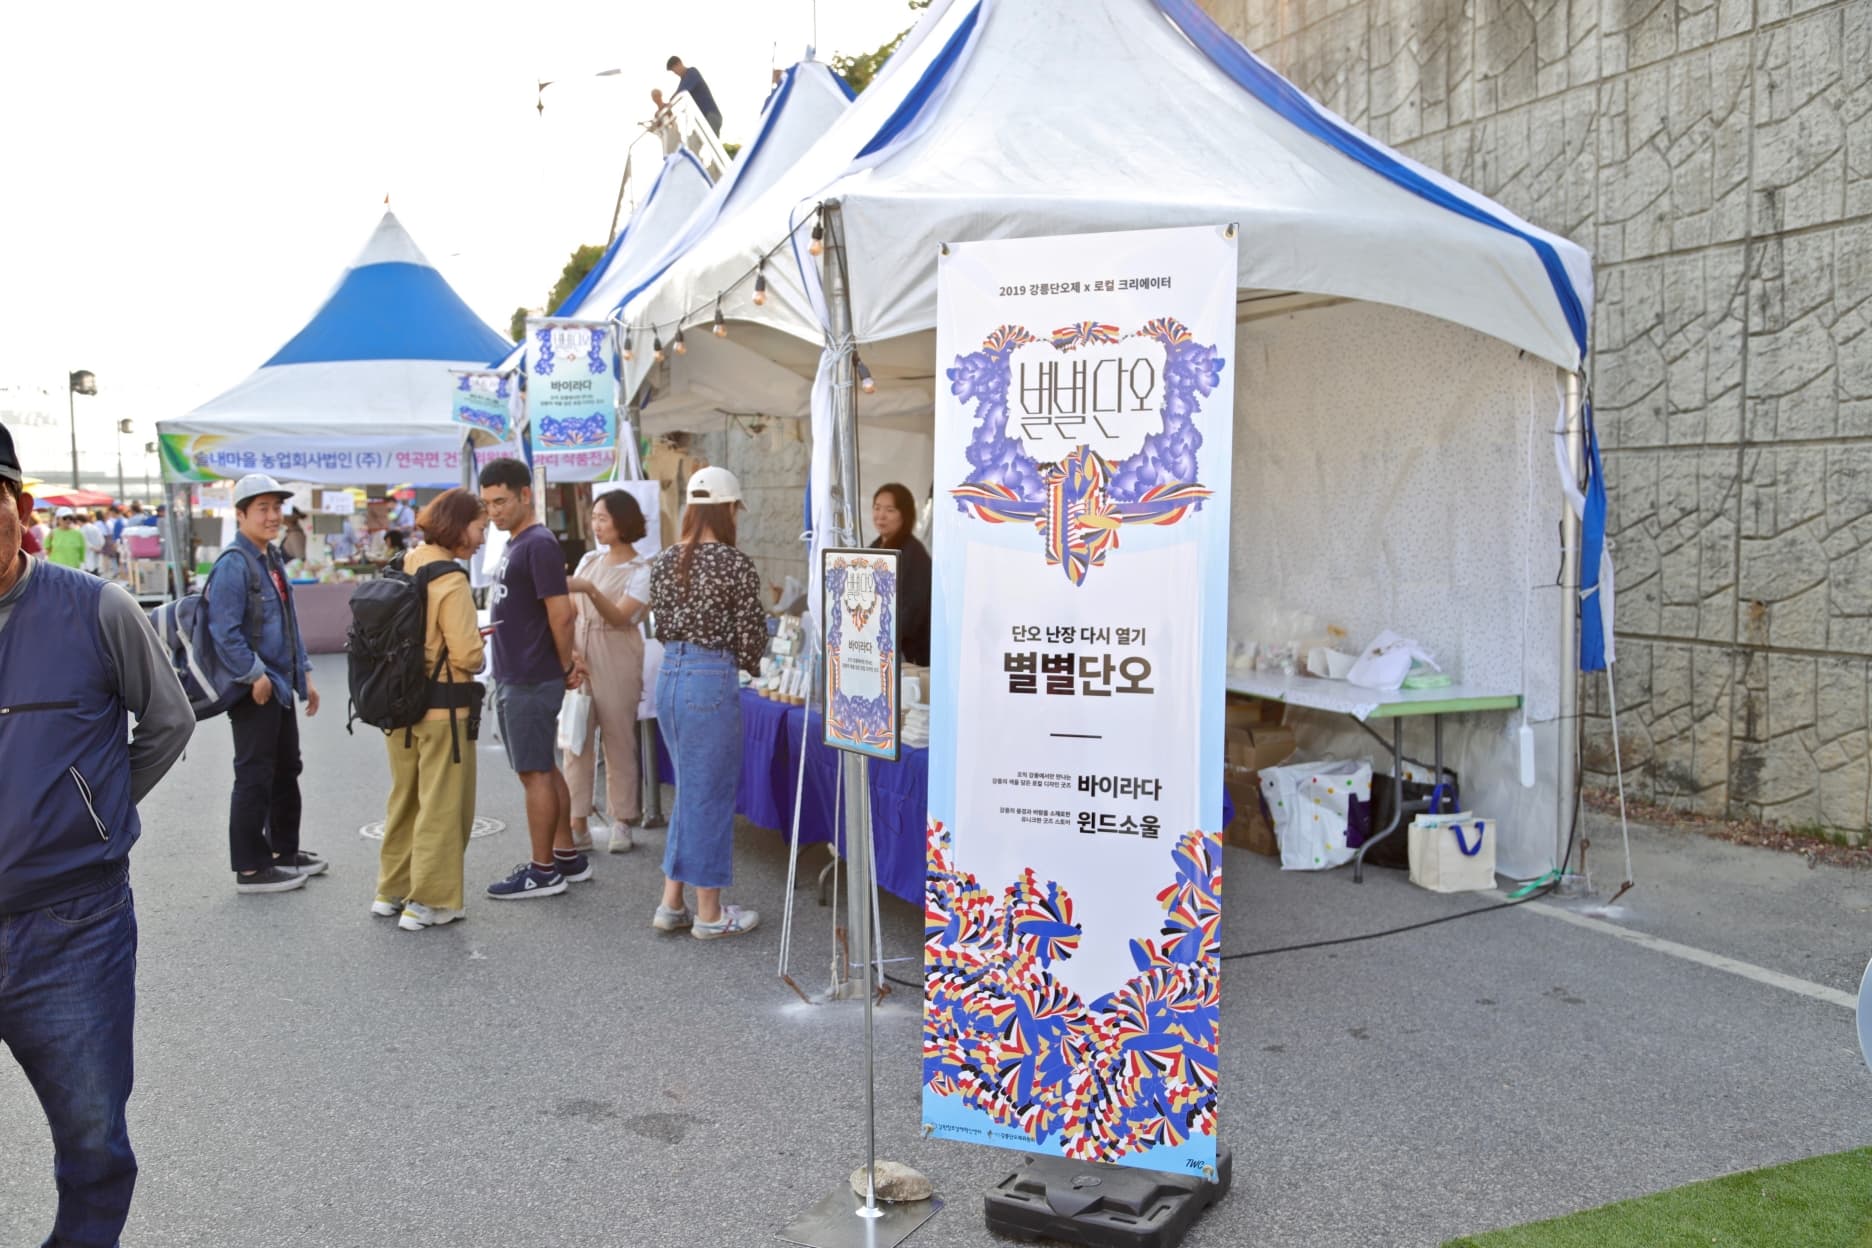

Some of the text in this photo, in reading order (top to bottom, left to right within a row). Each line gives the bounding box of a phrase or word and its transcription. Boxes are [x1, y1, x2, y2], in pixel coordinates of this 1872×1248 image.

[999, 284, 1027, 297] 2019
[1029, 280, 1081, 296] 강릉단오제
[1093, 279, 1115, 293] 로컬
[1117, 276, 1172, 292] 크리에이터
[550, 379, 592, 393] 바이라다
[1020, 357, 1156, 440] 별별단오
[261, 451, 353, 469] 농업회사법인
[356, 451, 382, 469] (주)
[395, 450, 441, 469] 연곡면
[1011, 625, 1146, 646] 단오 난장 다시 열기
[848, 639, 873, 655] 바이라다
[1003, 651, 1155, 697] 별별단오
[1077, 774, 1163, 802] 바이라다
[1076, 811, 1161, 840] 윈드소울
